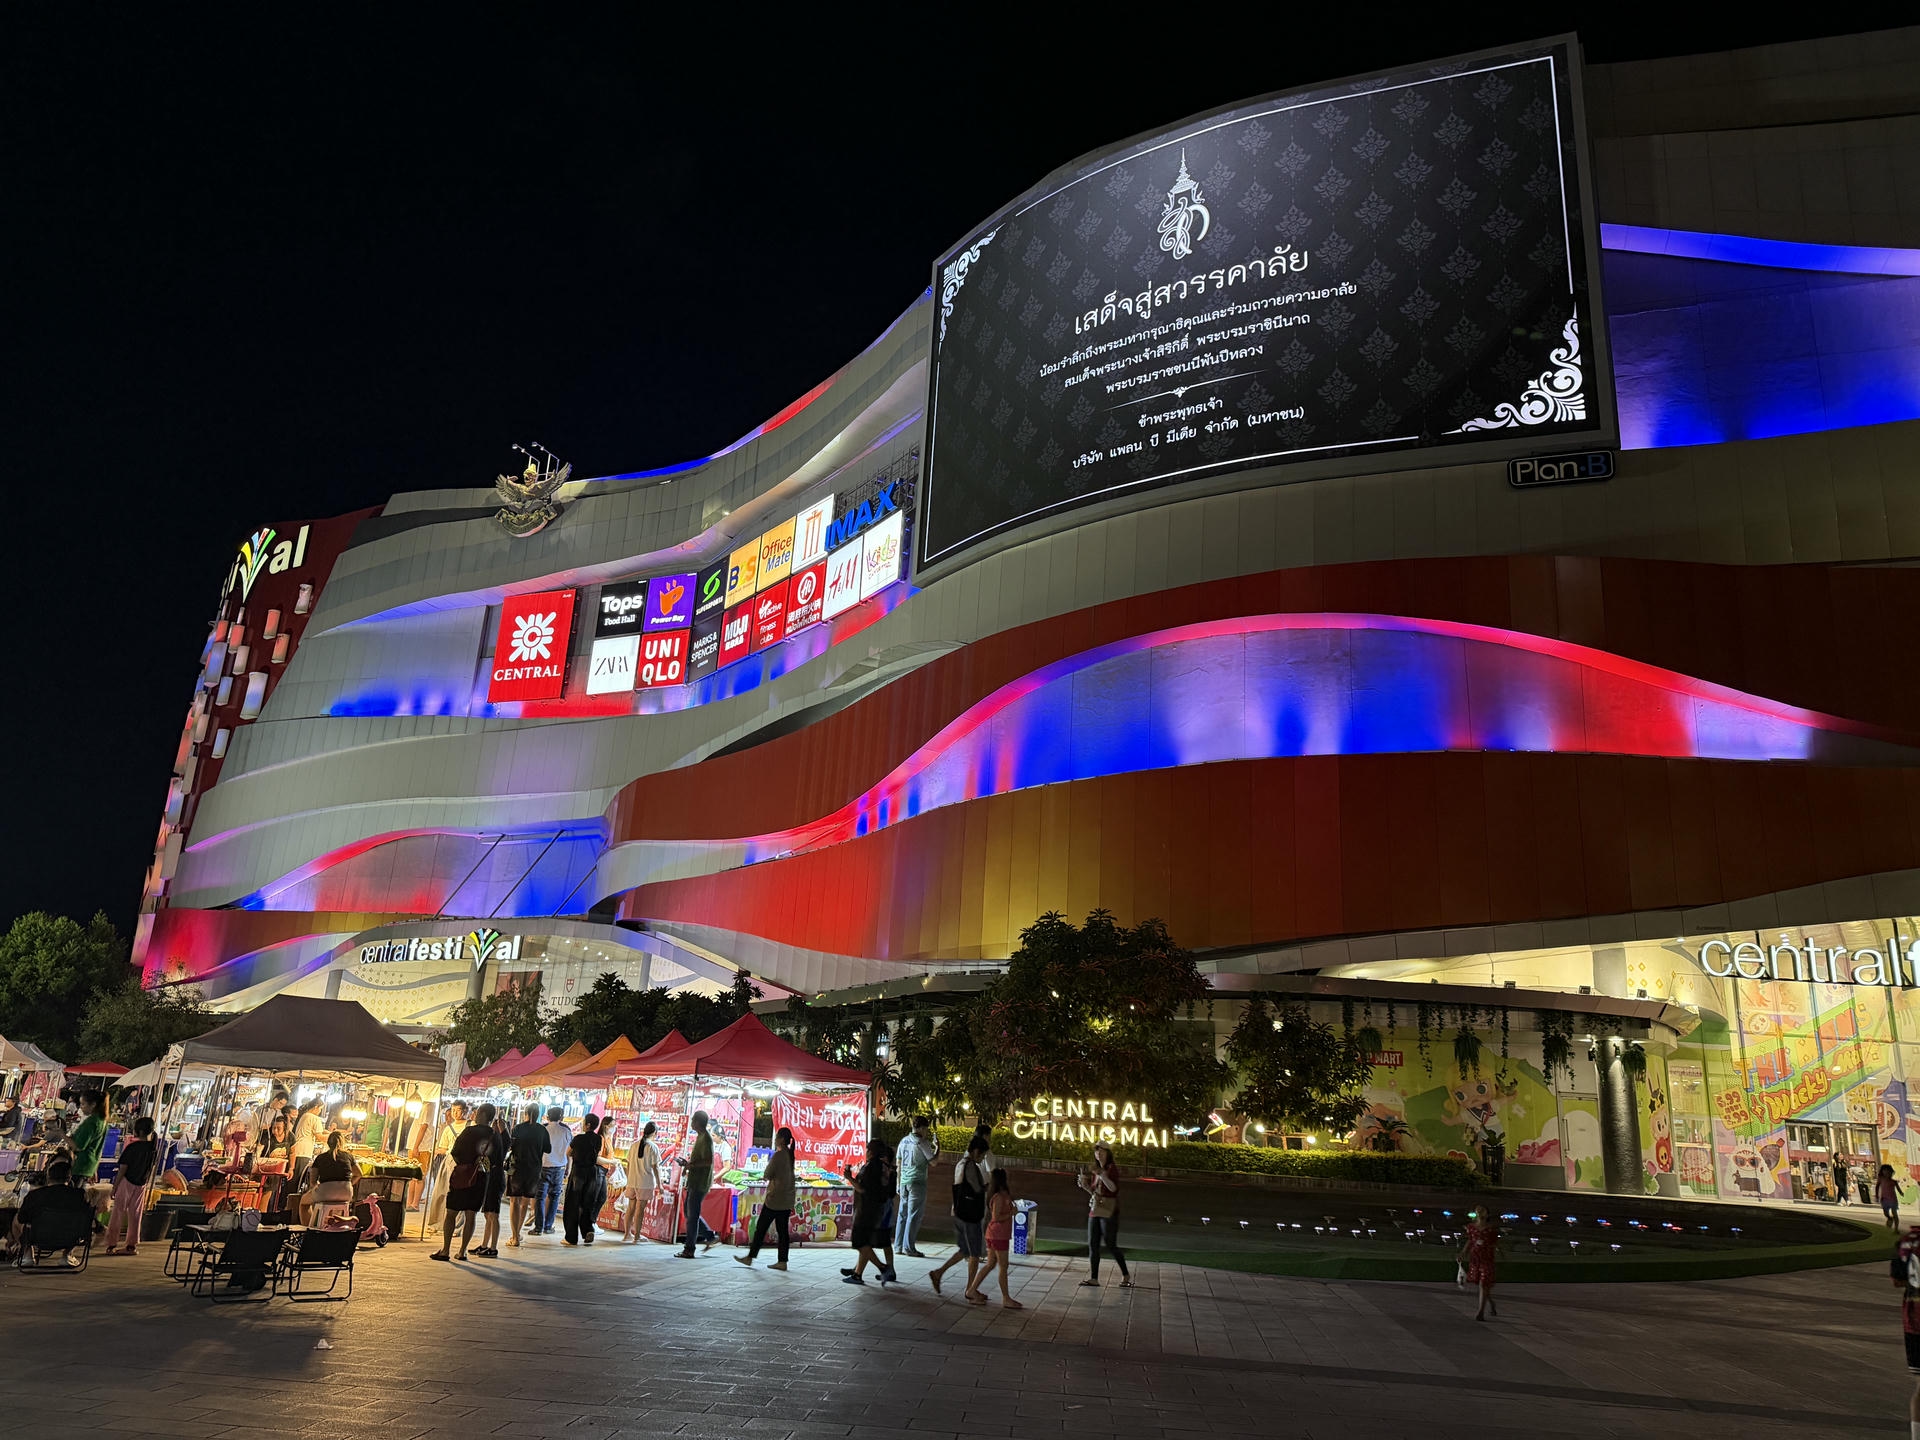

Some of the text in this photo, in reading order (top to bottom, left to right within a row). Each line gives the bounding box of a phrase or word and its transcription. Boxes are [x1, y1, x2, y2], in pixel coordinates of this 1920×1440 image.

[1074, 244, 1309, 335] เสด็จสู่สวรรคาลัย
[1138, 396, 1224, 428] ข้าพระพุทธเจ้า
[1072, 448, 1104, 470] บริษัท
[1109, 440, 1143, 459] แพลน
[1166, 428, 1197, 444] มีเดีย
[1204, 416, 1239, 435] จำกัด
[1247, 405, 1305, 428] (มหาชน)
[824, 480, 898, 550] IMAX
[761, 535, 793, 560] Office
[728, 555, 758, 592] B2S
[765, 549, 791, 574] Mate
[601, 594, 643, 615] Tops
[604, 615, 636, 626] Food Hall
[650, 617, 672, 625] Power
[724, 614, 749, 643] MUJI
[760, 621, 777, 635] fitness
[645, 637, 681, 660] UNI
[693, 634, 712, 651] MARKS
[760, 633, 774, 645] clubs
[690, 642, 718, 663] SPENCER
[493, 664, 561, 682] CENTRAL
[594, 655, 629, 676] ZARA
[642, 660, 680, 685] QLO
[551, 996, 579, 1006] TUDO
[1762, 1070, 1830, 1122] Wacky
[1033, 1098, 1153, 1123] CENTRAL
[1013, 1120, 1167, 1149] CHIANGMAI
[804, 1139, 812, 1153] &
[849, 1144, 864, 1156] TEA
